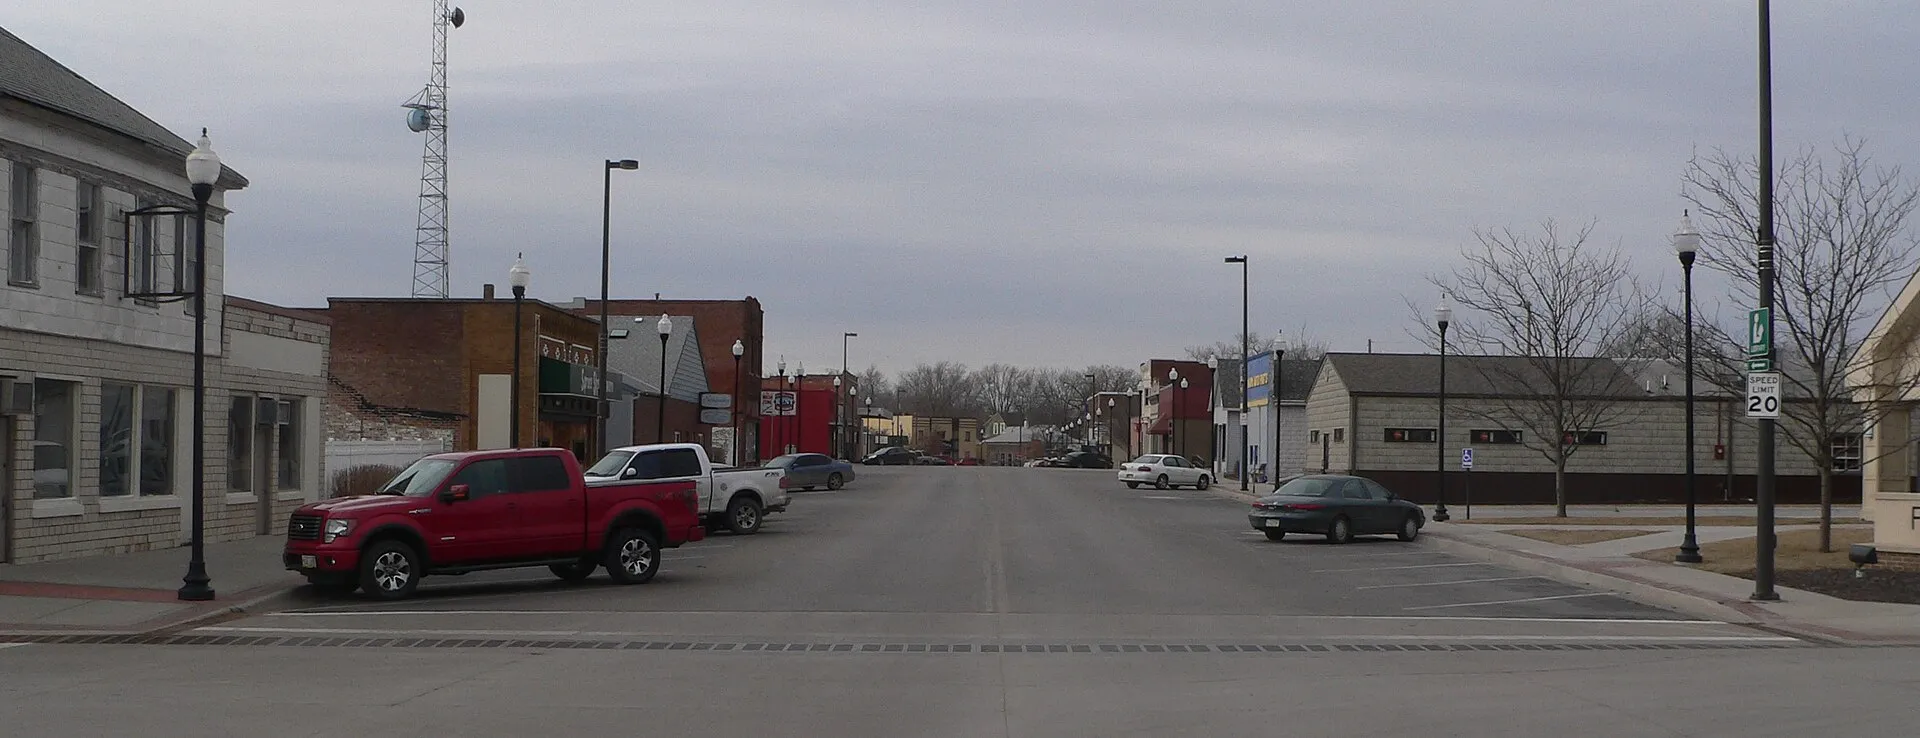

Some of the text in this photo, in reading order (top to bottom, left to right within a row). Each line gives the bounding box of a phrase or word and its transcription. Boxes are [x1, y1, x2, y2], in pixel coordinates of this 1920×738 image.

[1749, 376, 1778, 384] SPEED
[1752, 386, 1775, 394] LIMIT
[1748, 396, 1778, 413] 20
